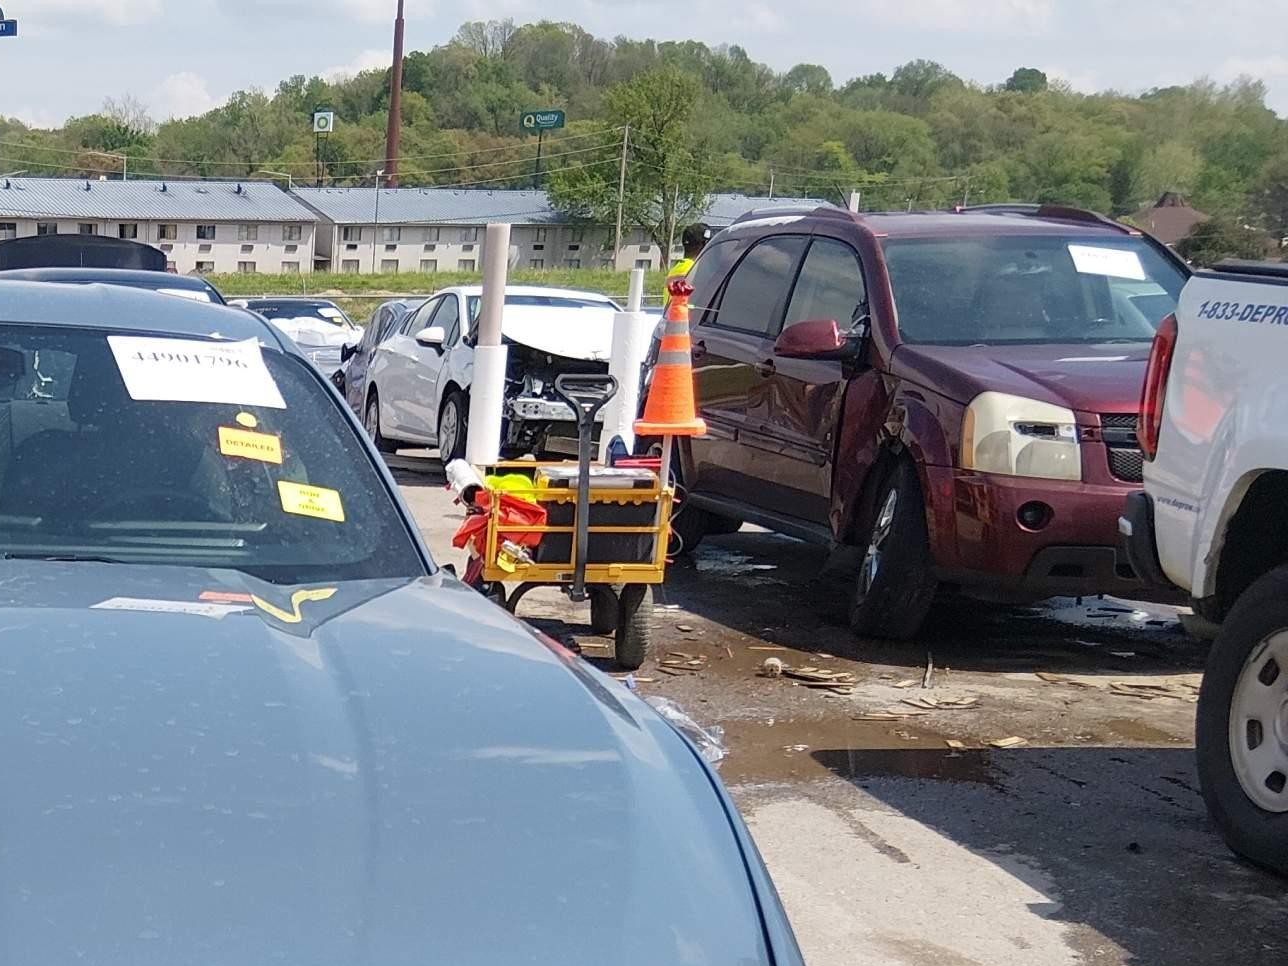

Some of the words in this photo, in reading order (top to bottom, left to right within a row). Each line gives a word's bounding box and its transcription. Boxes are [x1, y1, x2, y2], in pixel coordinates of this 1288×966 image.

[536, 113, 559, 123] Quality
[131, 351, 249, 369] 44901796
[225, 439, 275, 453] DETAILED
